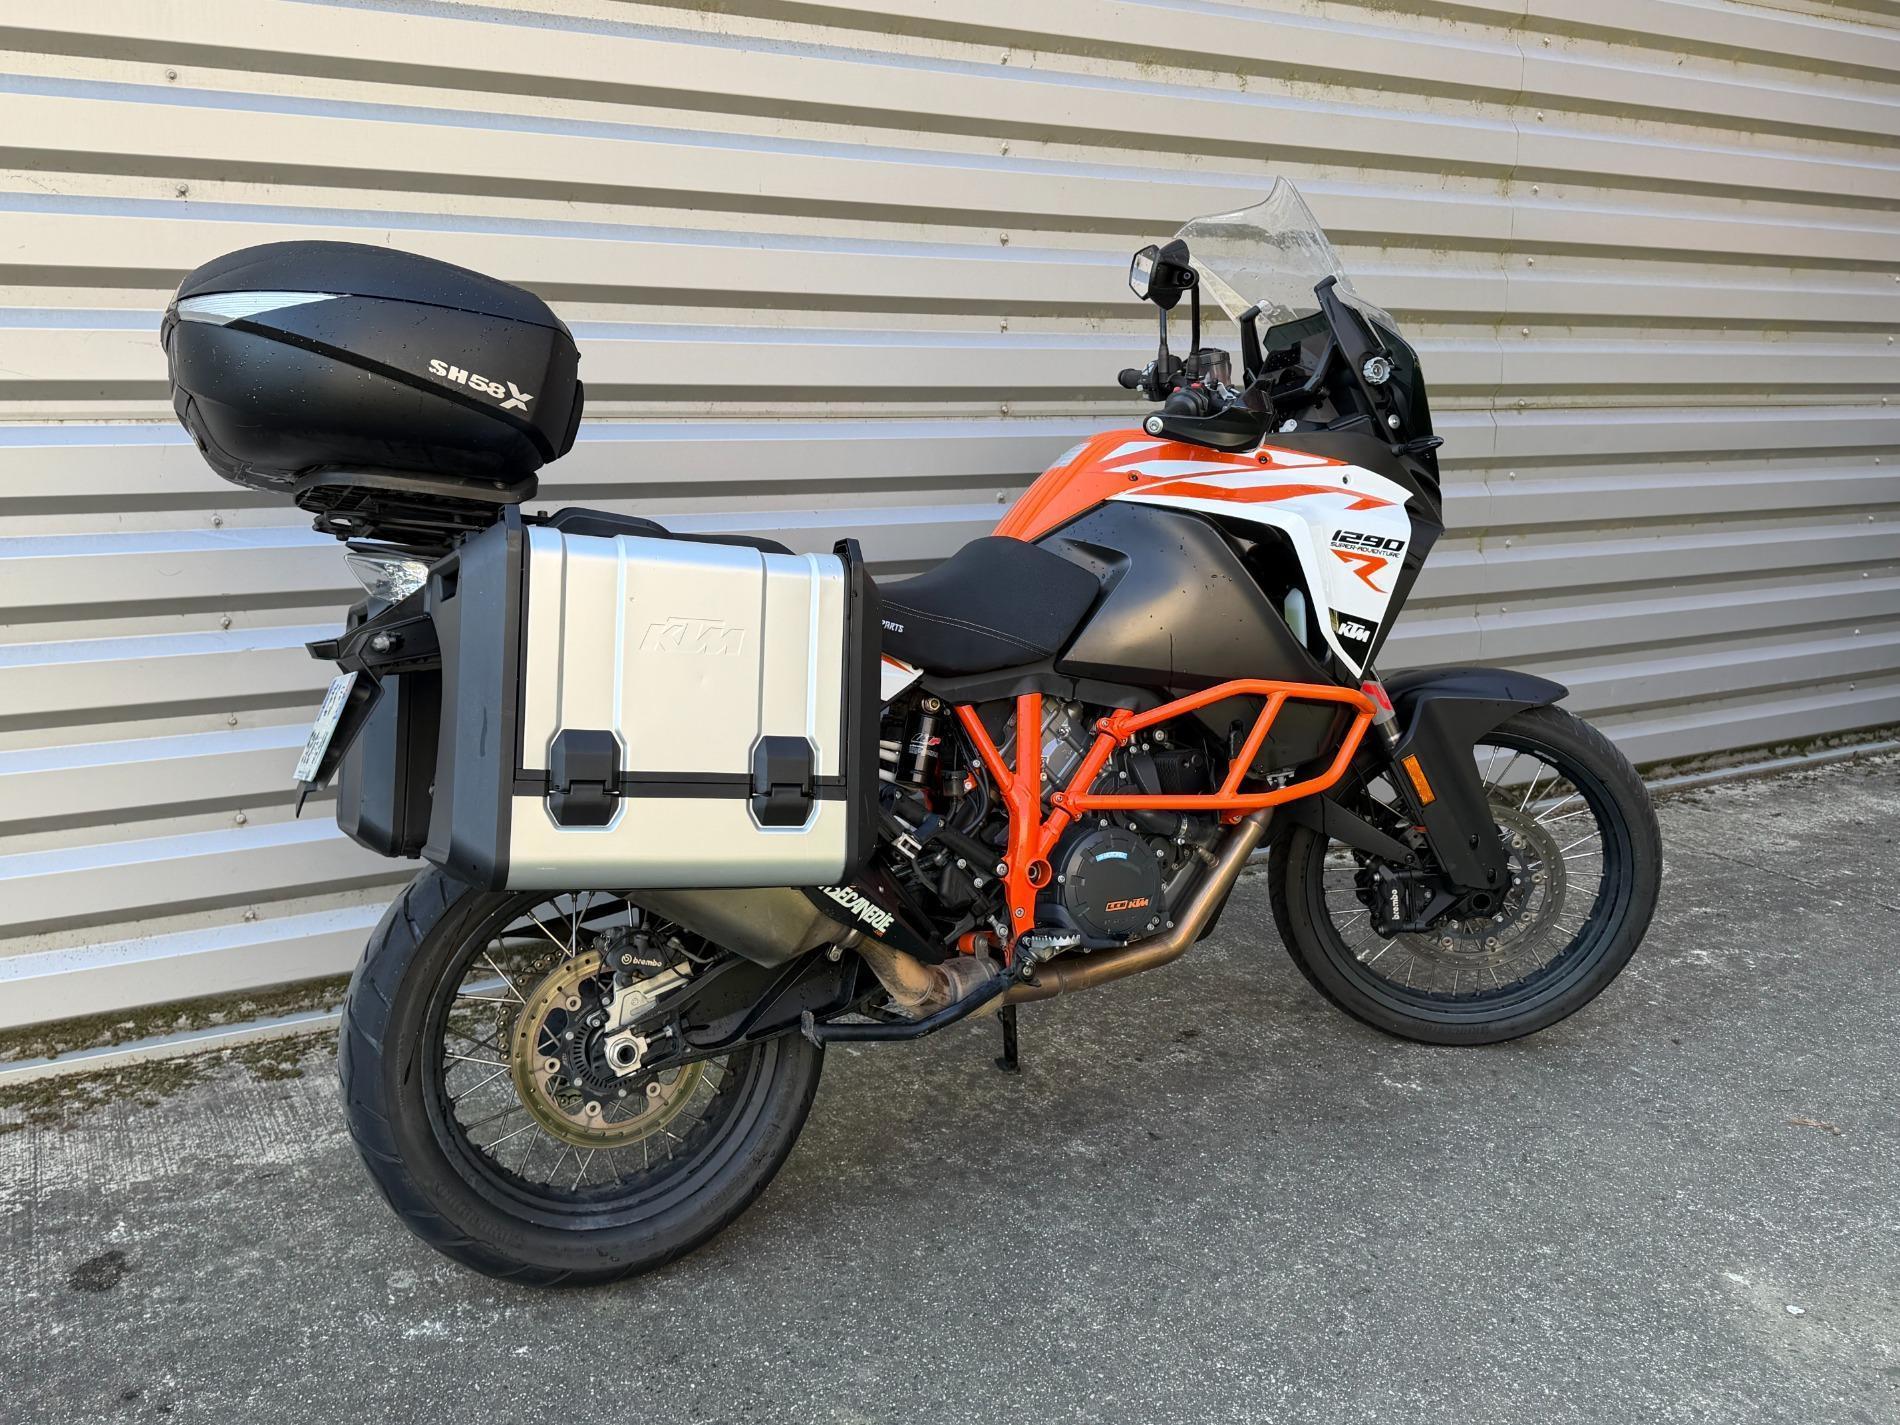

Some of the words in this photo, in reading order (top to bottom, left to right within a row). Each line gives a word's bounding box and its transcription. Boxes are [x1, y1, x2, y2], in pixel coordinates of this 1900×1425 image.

[428, 358, 534, 411] SH58X
[1332, 529, 1406, 553] 1290
[638, 617, 746, 656] KTM
[1337, 620, 1371, 643] KTM
[1128, 897, 1149, 909] KTM
[1389, 889, 1401, 920] brembo
[632, 956, 663, 967] brembo
